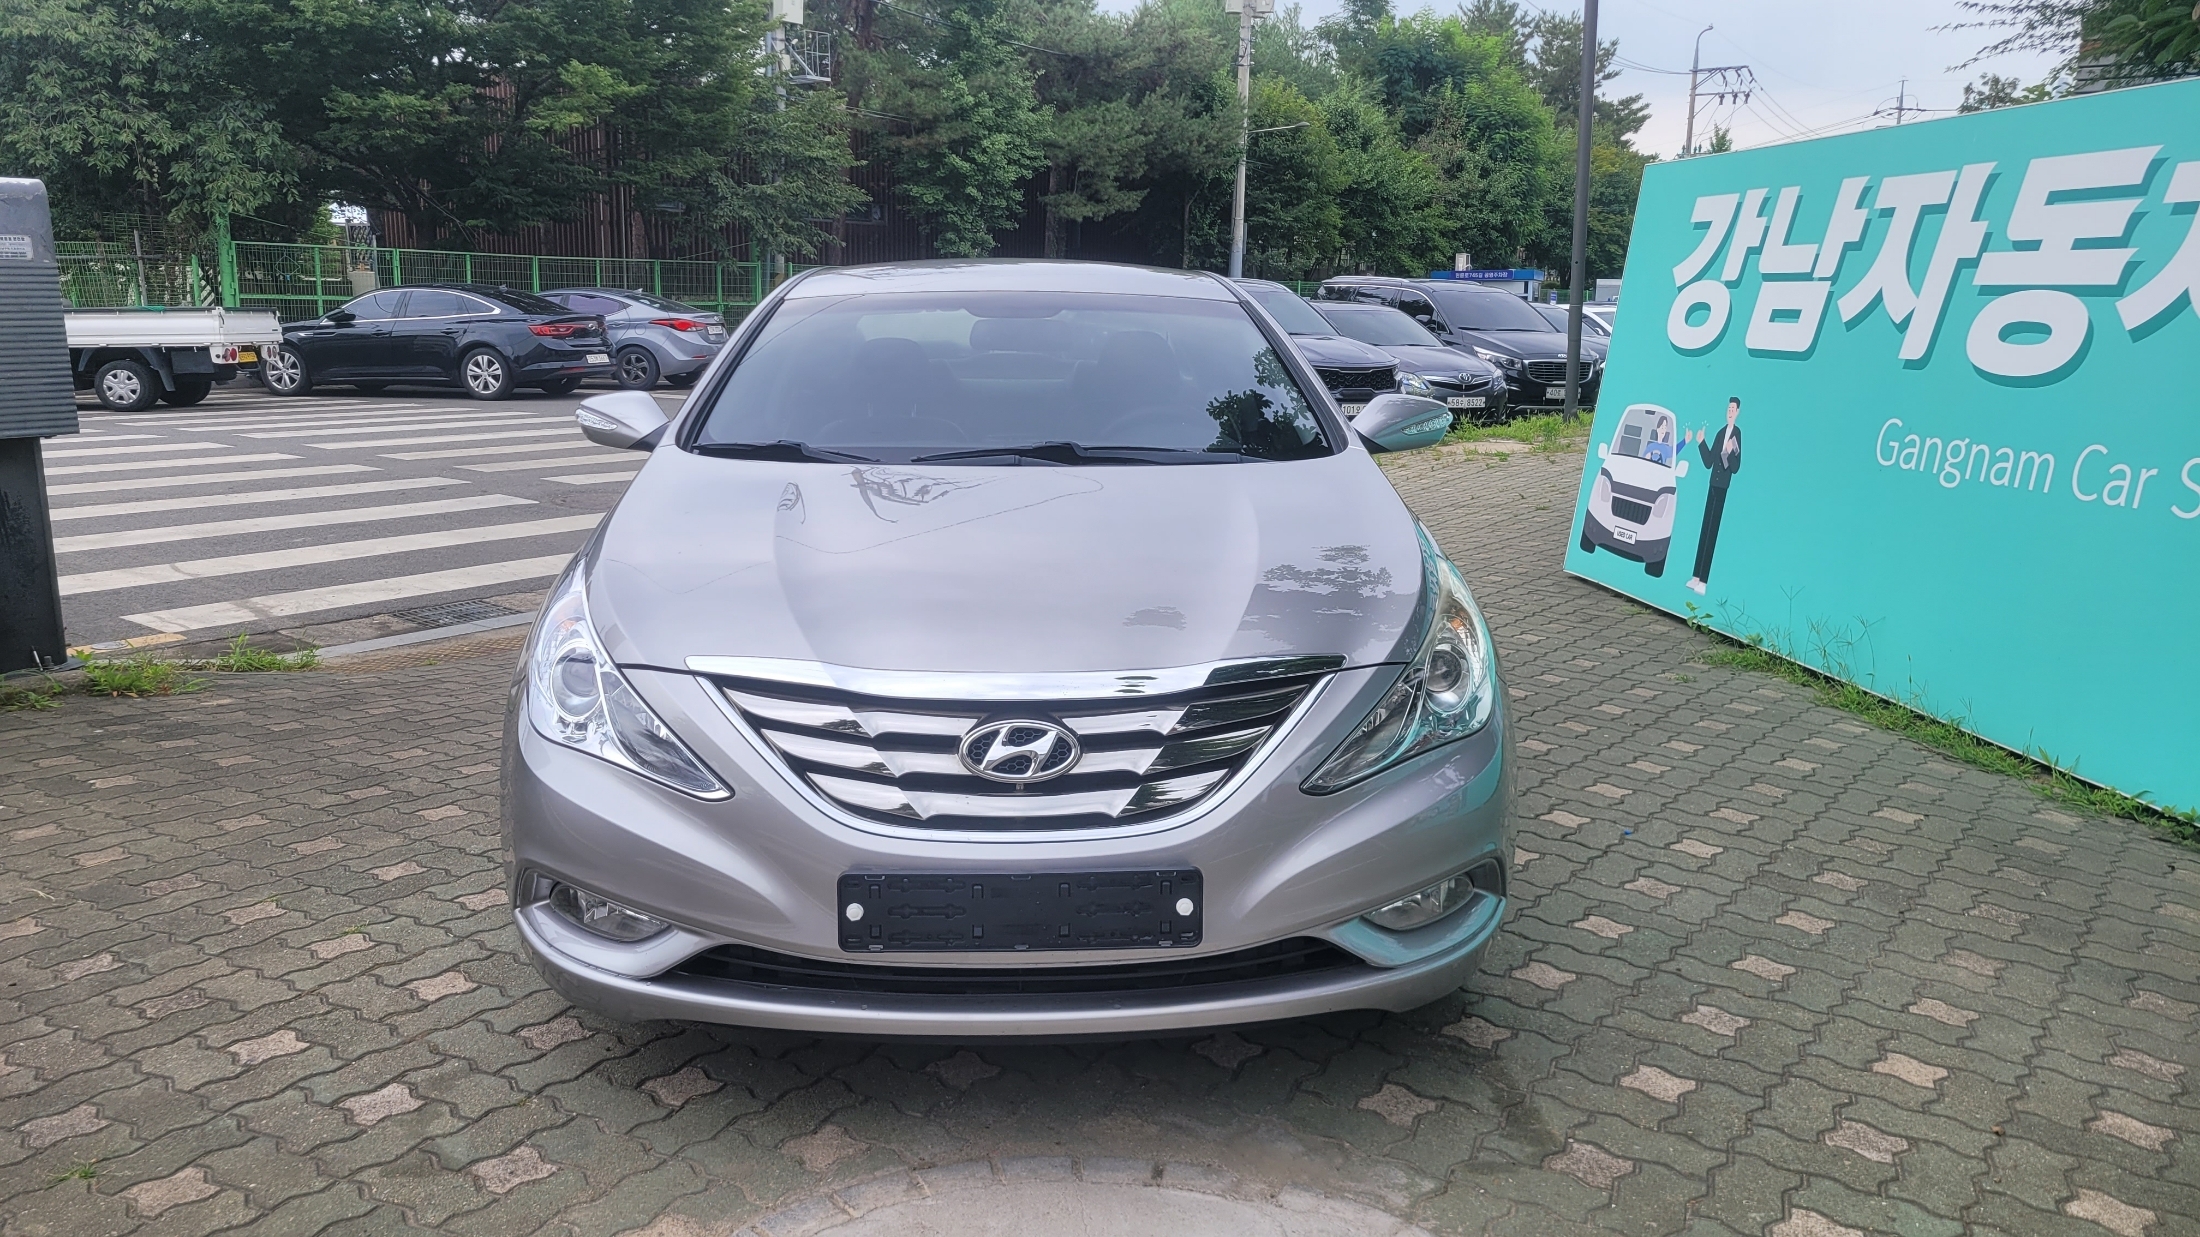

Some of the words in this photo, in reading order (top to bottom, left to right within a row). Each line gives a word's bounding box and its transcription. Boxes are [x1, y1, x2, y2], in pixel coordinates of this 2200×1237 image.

[1466, 398, 1483, 407] 8522
[1875, 418, 2056, 493] Gangnam
[2071, 443, 2159, 509] Car
[1625, 532, 1633, 541] CAR
